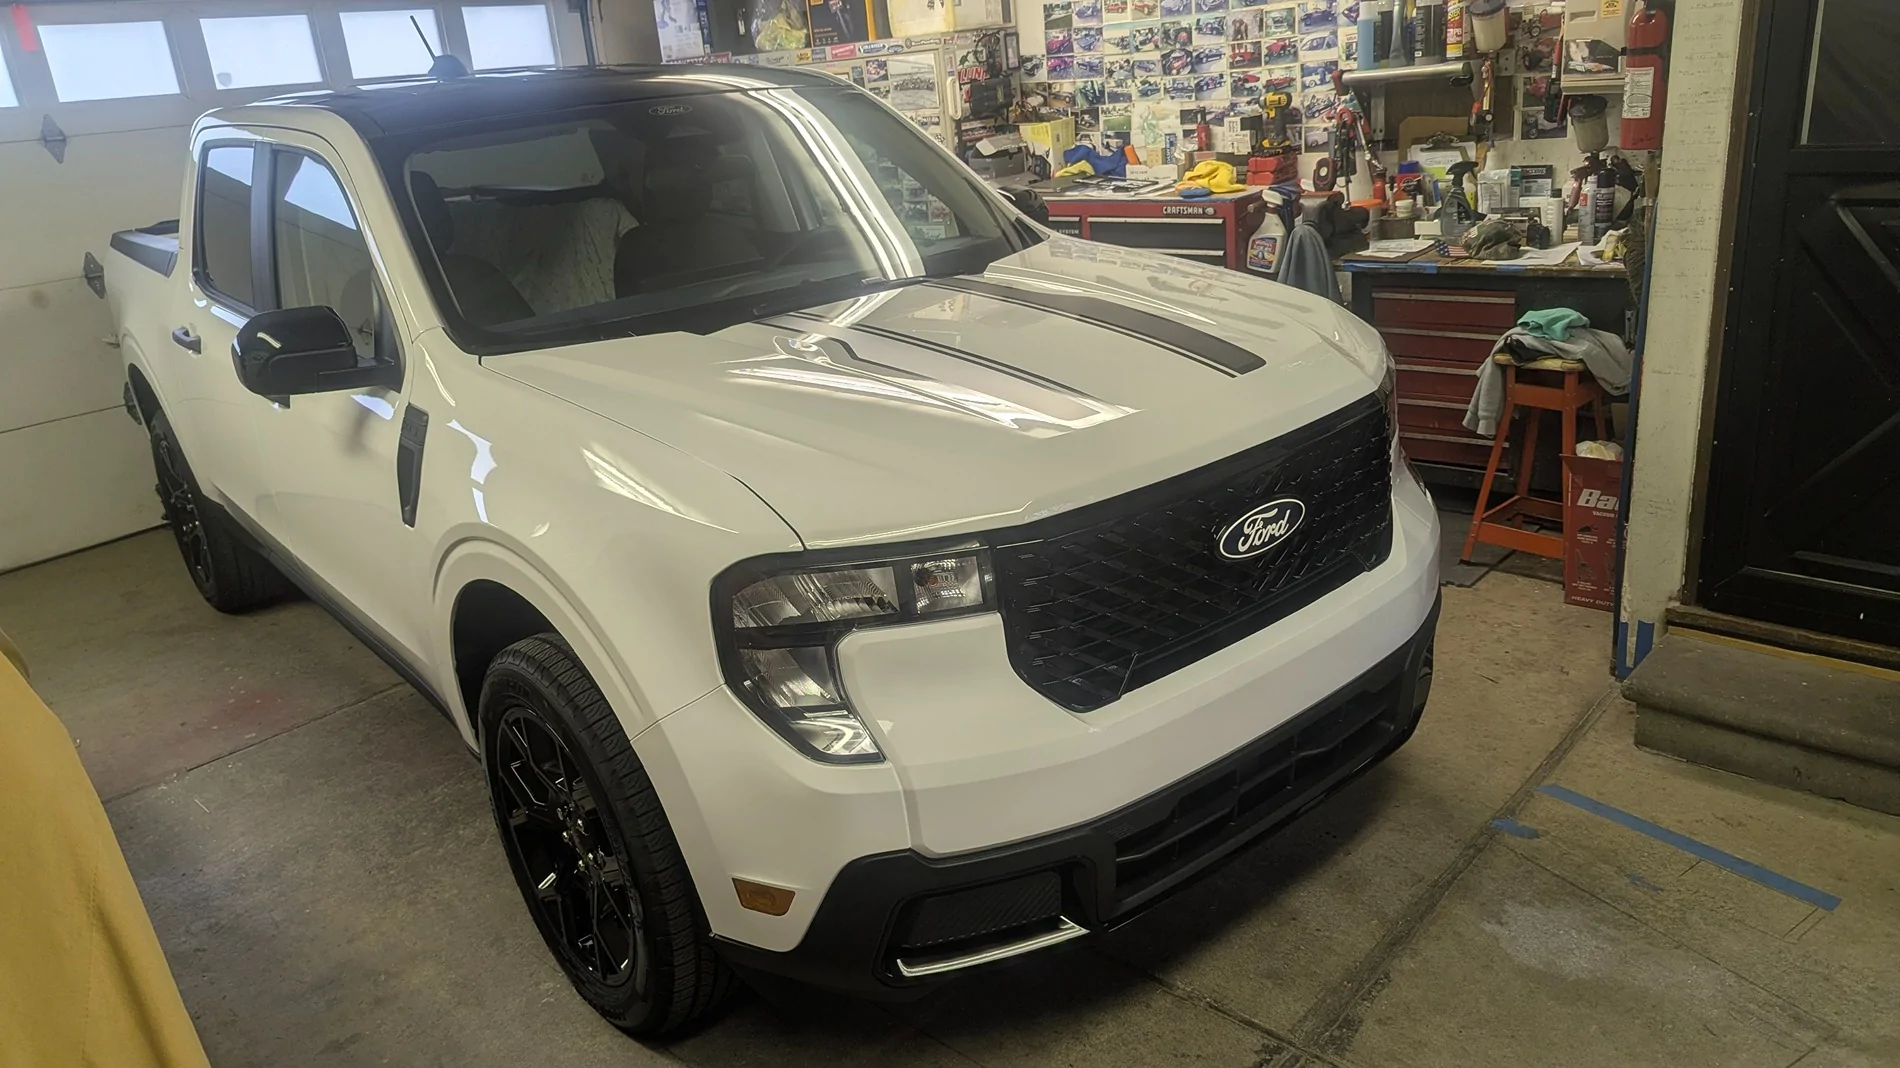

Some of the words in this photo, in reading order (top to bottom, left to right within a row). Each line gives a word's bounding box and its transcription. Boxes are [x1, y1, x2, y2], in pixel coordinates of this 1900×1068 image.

[656, 105, 686, 115] Ford
[1162, 205, 1203, 215] CRAFTSMAN
[1237, 508, 1291, 552] Ford
[1571, 595, 1594, 603] HEAVY
[1595, 599, 1615, 607] DUTY
